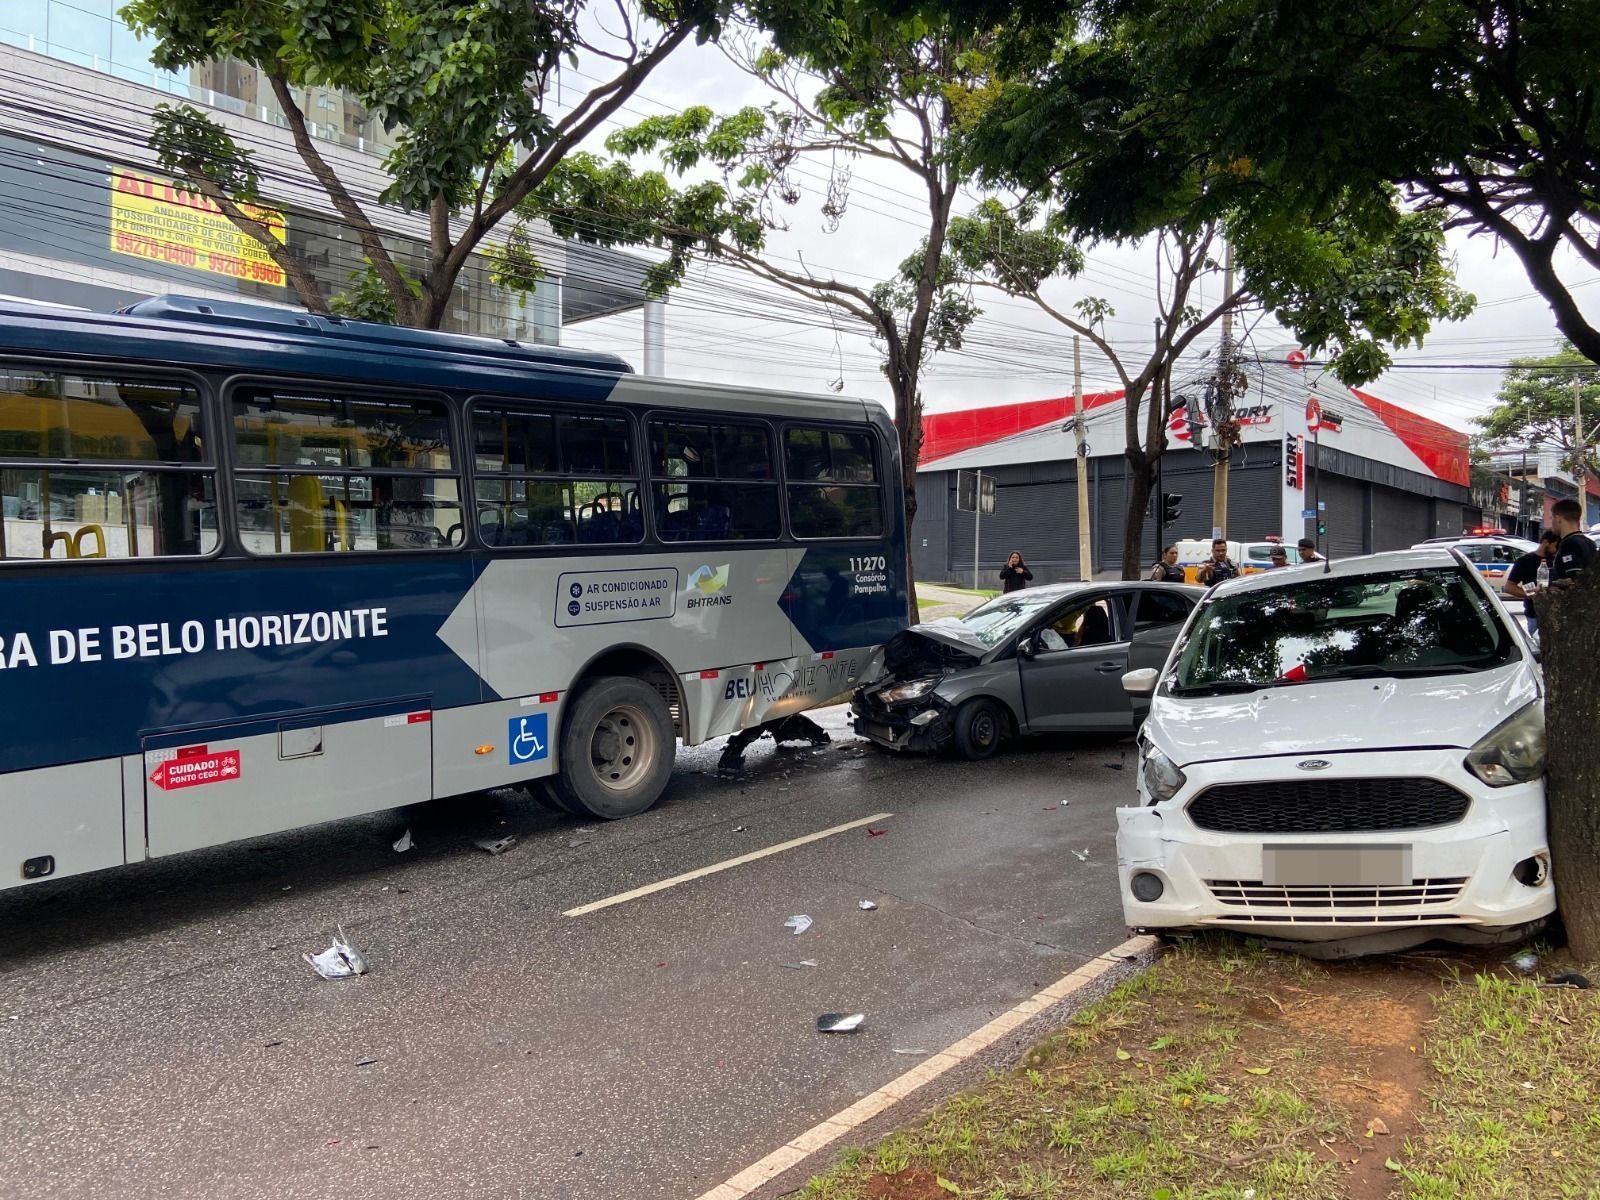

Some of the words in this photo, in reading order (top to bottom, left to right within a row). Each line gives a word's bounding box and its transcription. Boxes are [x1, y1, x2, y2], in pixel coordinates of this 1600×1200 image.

[116, 208, 198, 234] POSSIBILIDADES
[201, 228, 213, 238] DE
[153, 206, 200, 223] ANDARES
[202, 217, 243, 233] CORRID
[130, 222, 164, 237] DIREITO
[214, 241, 240, 254] VAGAS
[116, 229, 196, 267] 99279-0400
[1232, 404, 1274, 419] ORY
[1286, 431, 1297, 489] STORY
[849, 556, 886, 571] 11270
[855, 572, 886, 583] Consórcio
[586, 584, 600, 594] AR
[601, 579, 668, 593] CONDICIONADO
[854, 582, 887, 595] Pampulha
[584, 597, 639, 612] SUSPENSÃO
[641, 599, 648, 608] A
[649, 598, 661, 607] AR
[687, 595, 732, 609] BHTRANS
[49, 627, 101, 665] DE
[112, 620, 205, 660] BELO
[215, 607, 388, 650] HORIZONTE
[169, 759, 219, 775] CUIDADO!
[170, 773, 197, 785] PONTO
[198, 770, 219, 780] CEGO
